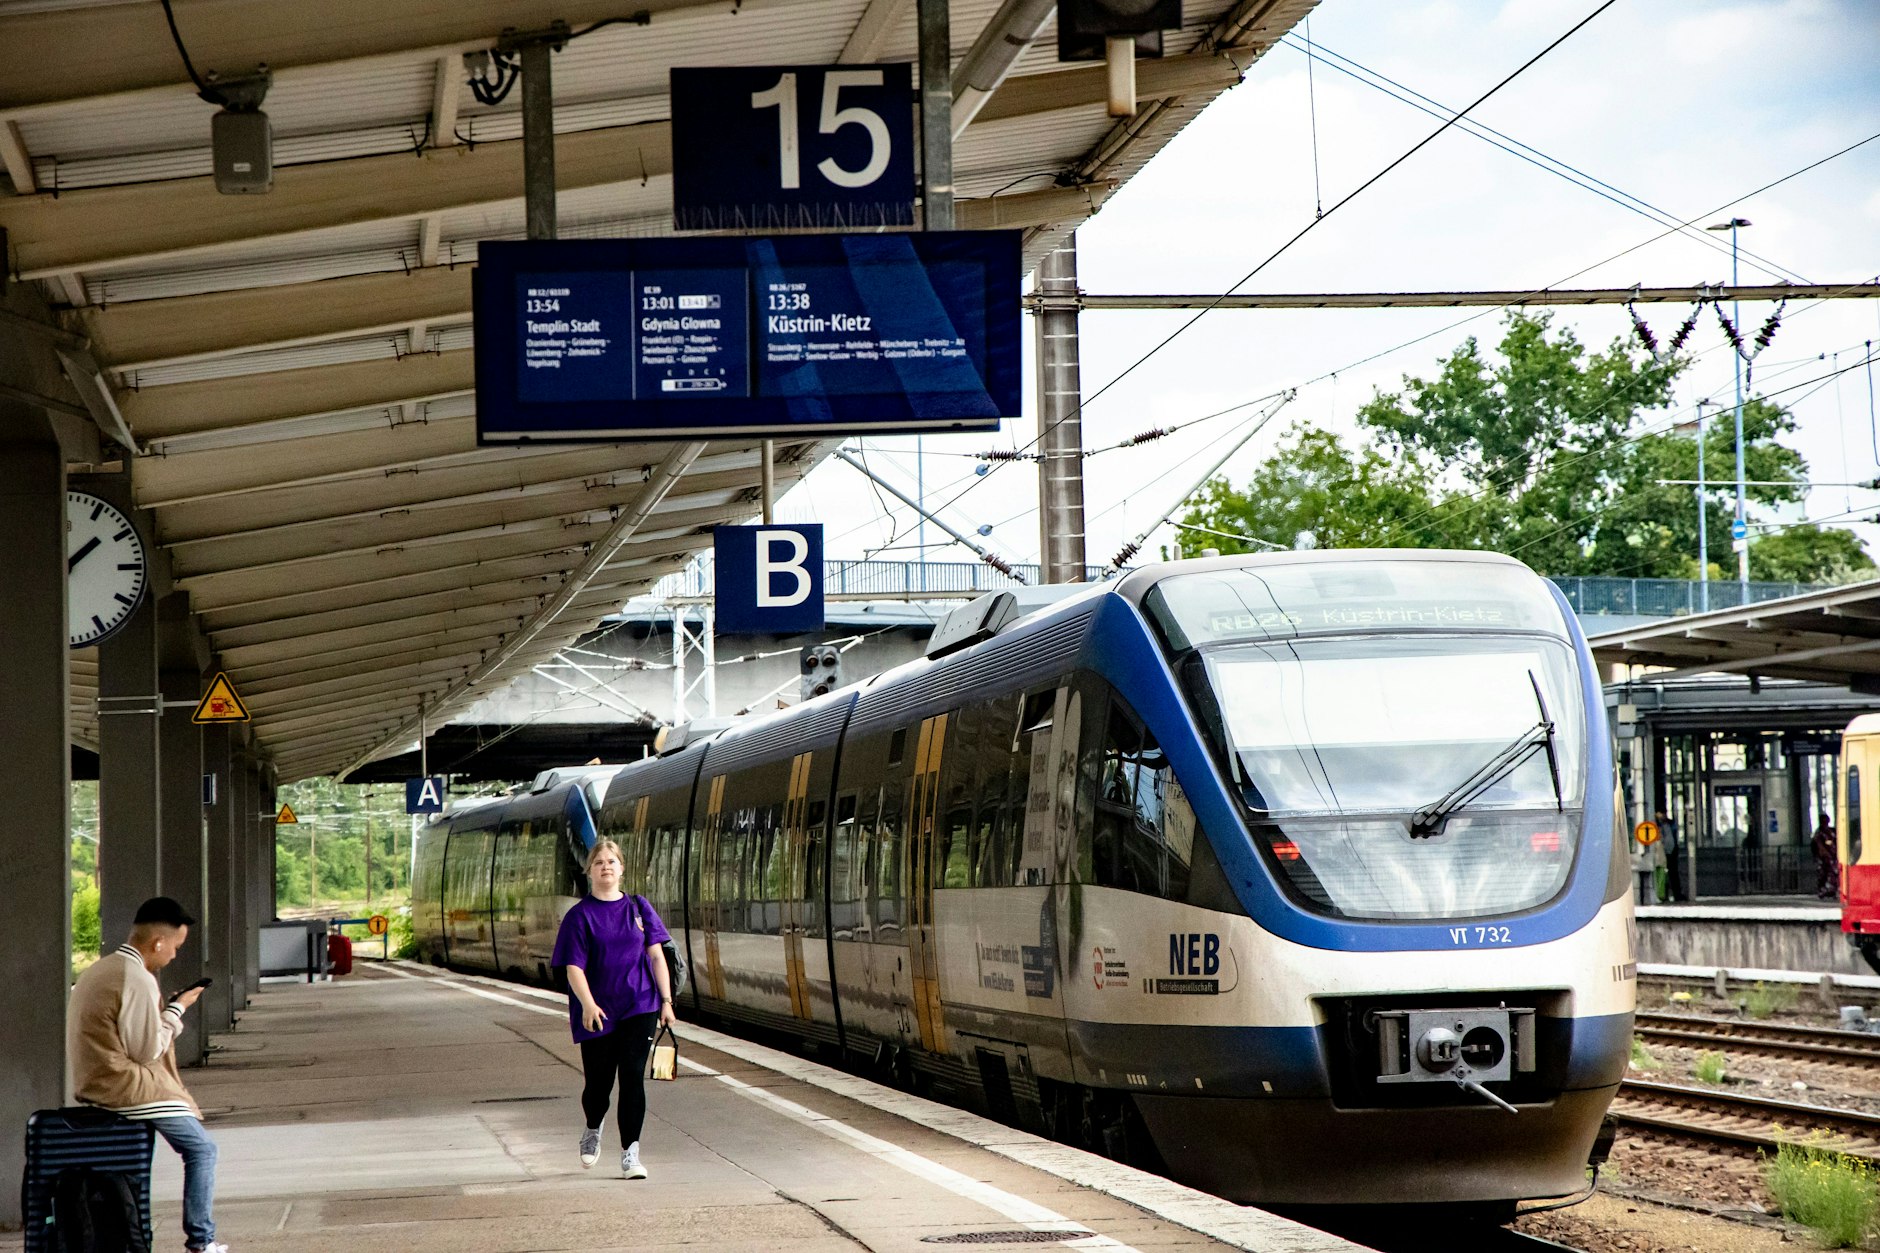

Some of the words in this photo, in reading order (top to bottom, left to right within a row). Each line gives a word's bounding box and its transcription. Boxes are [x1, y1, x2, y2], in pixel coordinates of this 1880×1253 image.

[751, 69, 891, 189] 15
[527, 298, 560, 313] 13:54
[642, 296, 675, 310] 13:01
[768, 293, 811, 310] 13:38
[526, 319, 570, 335] Templin
[570, 318, 601, 333] Stadt
[641, 316, 680, 333] Gdynia
[768, 314, 871, 334] Küstrin-Kietz
[756, 530, 812, 608] B
[1321, 606, 1503, 624] Küstrin-Kietz
[417, 779, 440, 806] A
[1449, 928, 1467, 944] VT
[1475, 927, 1511, 944] 732
[1170, 933, 1219, 975] NEB
[1160, 981, 1214, 994] Betriebsgesellschaft
